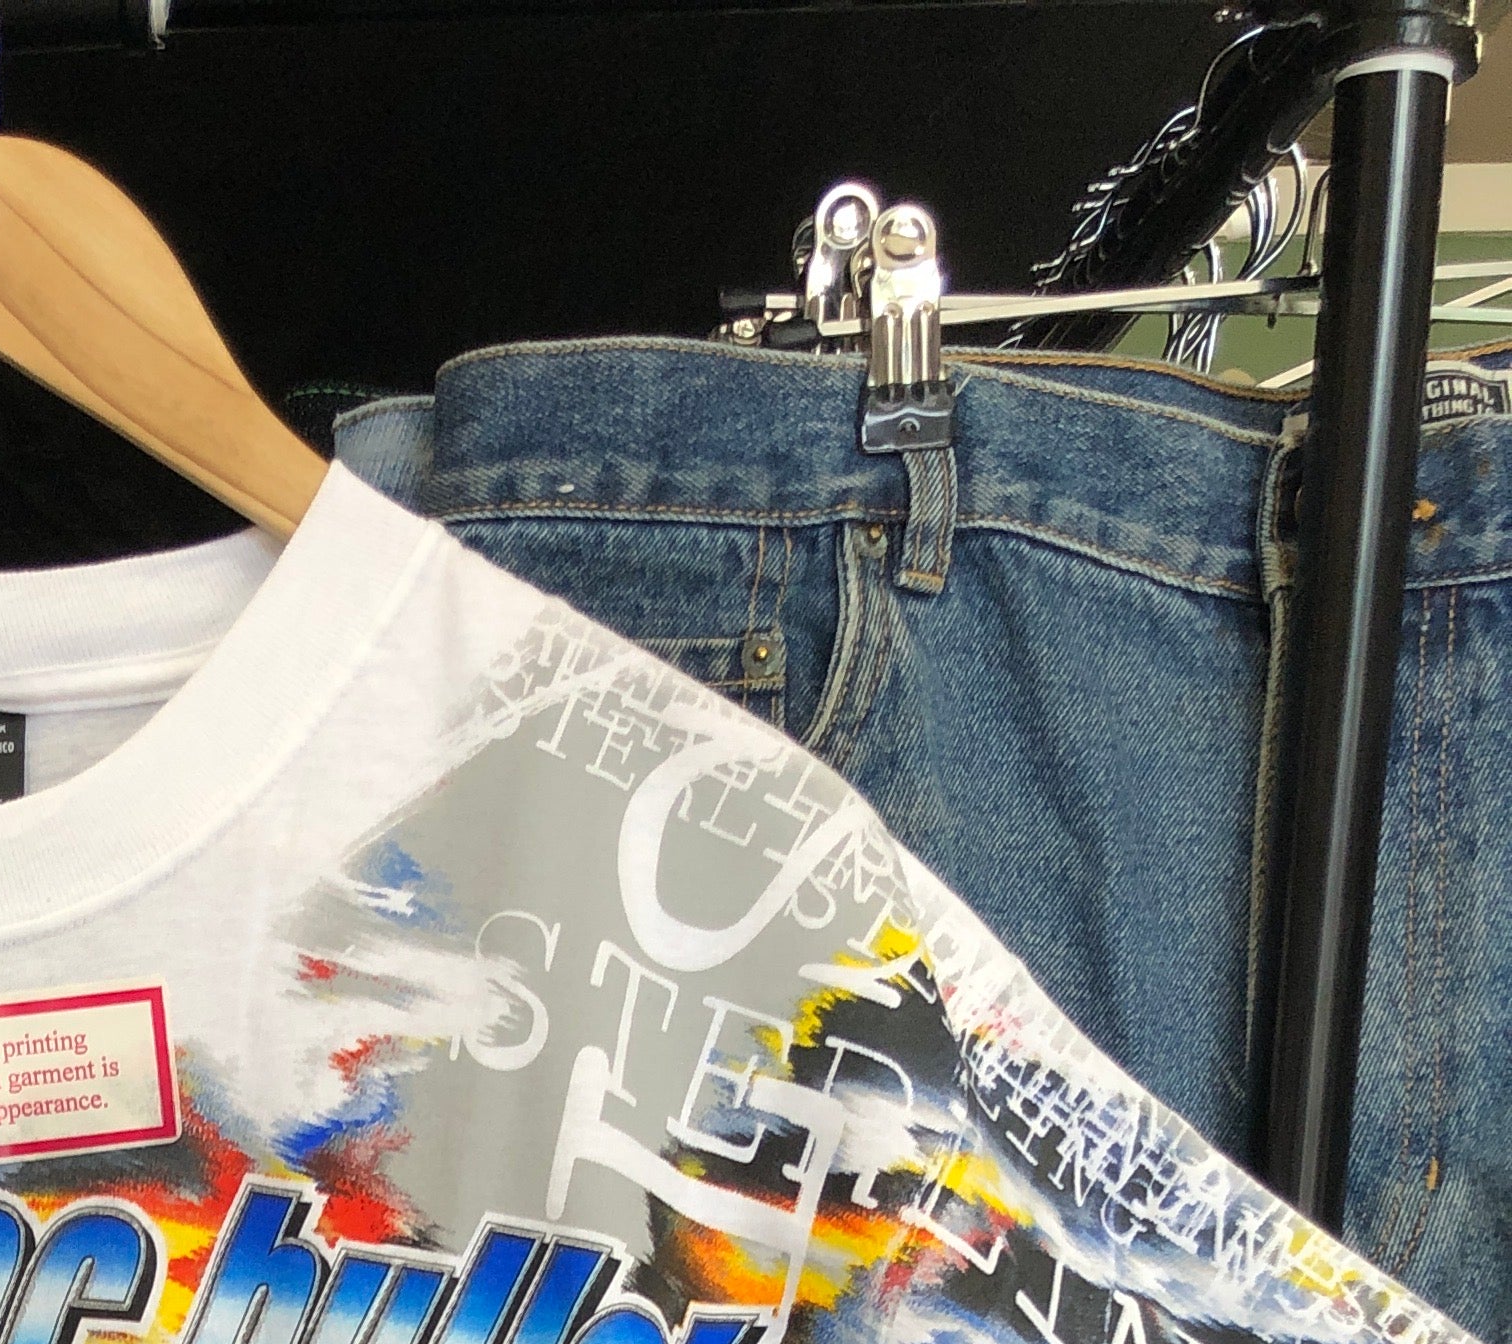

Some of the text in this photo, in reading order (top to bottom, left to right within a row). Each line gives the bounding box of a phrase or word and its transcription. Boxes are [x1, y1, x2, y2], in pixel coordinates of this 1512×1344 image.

[1426, 379, 1495, 405] GINAL
[1421, 399, 1474, 420] THING
[2, 1030, 88, 1064] printing
[8, 1060, 95, 1094] garment
[101, 1055, 120, 1078] is
